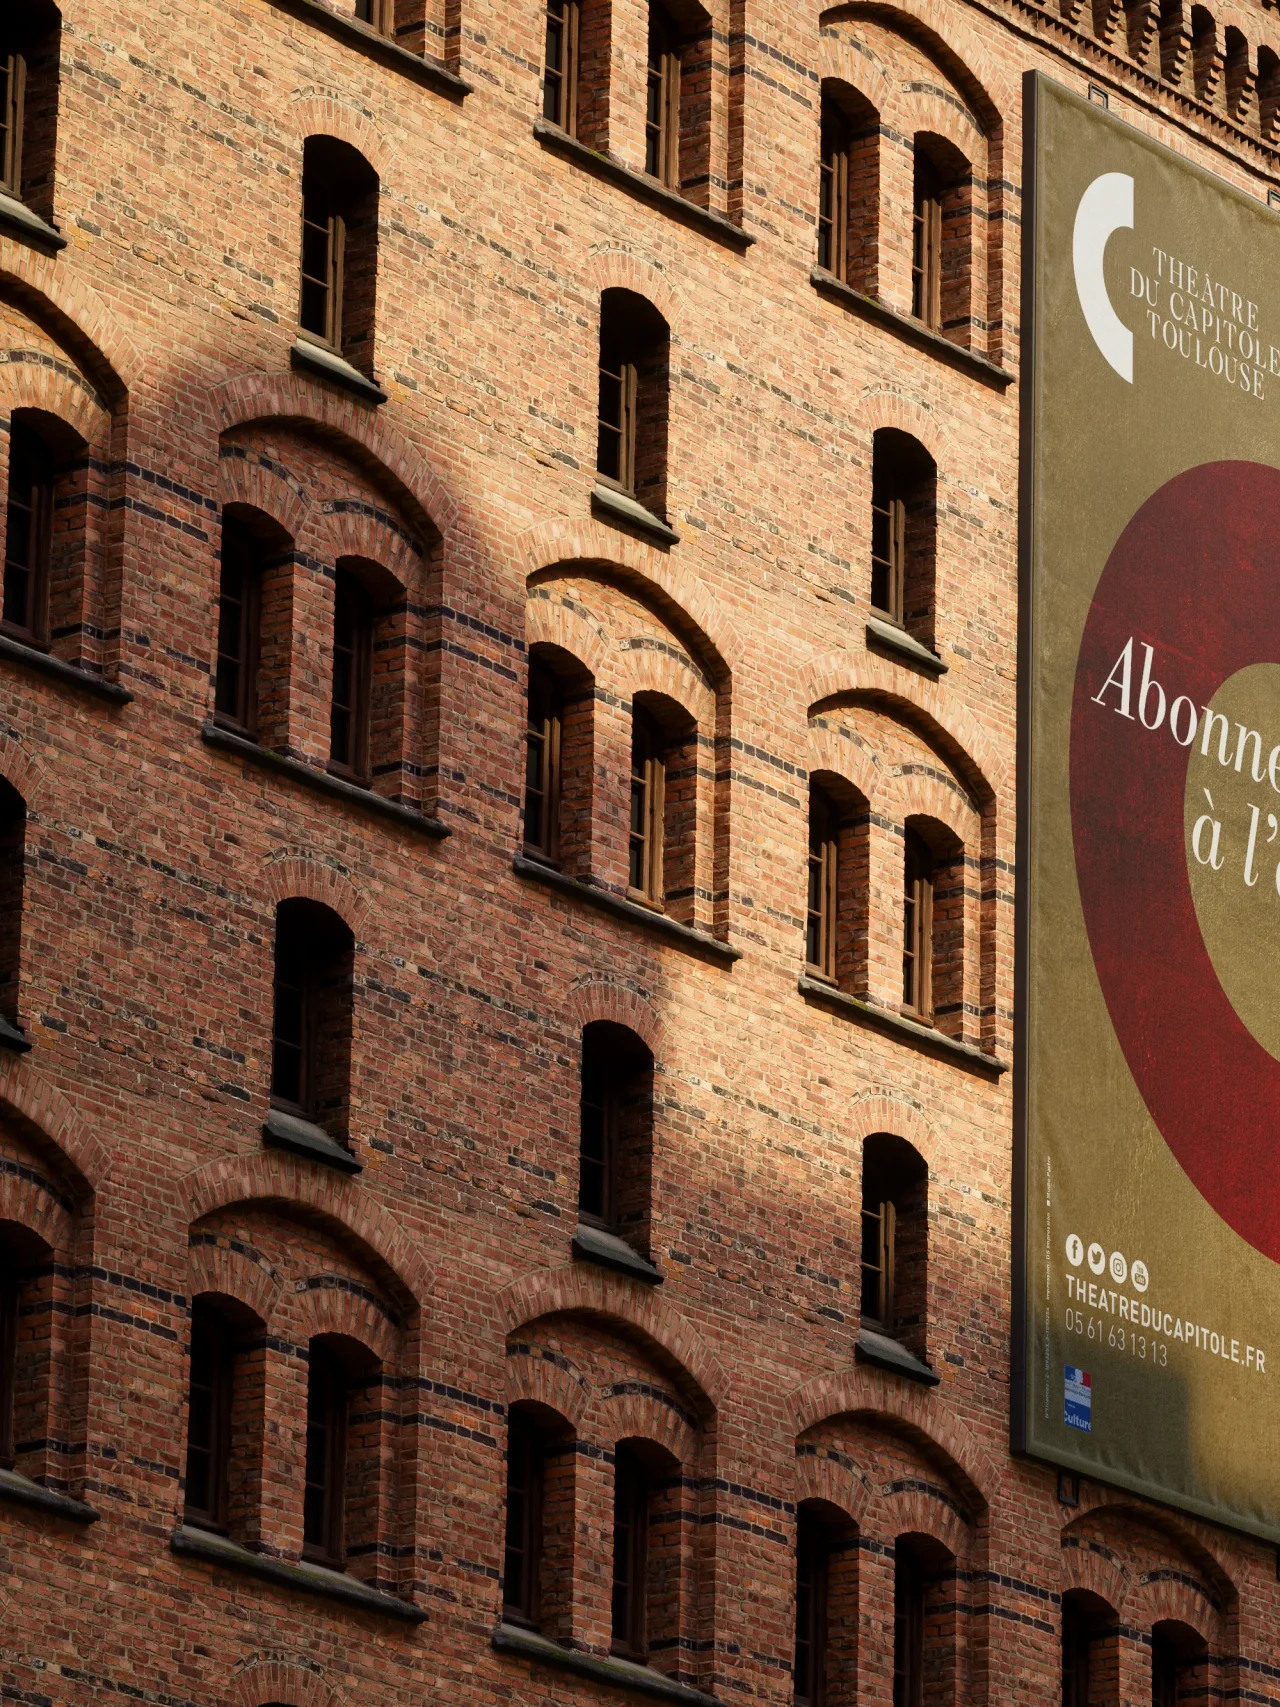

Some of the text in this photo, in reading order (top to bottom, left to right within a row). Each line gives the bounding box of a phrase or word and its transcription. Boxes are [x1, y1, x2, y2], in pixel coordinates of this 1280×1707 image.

[1129, 266, 1280, 377] DU CAPITOLE
[1152, 246, 1259, 332] THÉÂTRE
[1146, 309, 1264, 401] TOULOUSE
[1192, 788, 1225, 871] à
[1065, 1273, 1266, 1374] THEATREDUCAPITOLE.FR
[1065, 1307, 1168, 1367] 05 61 63 13 13
